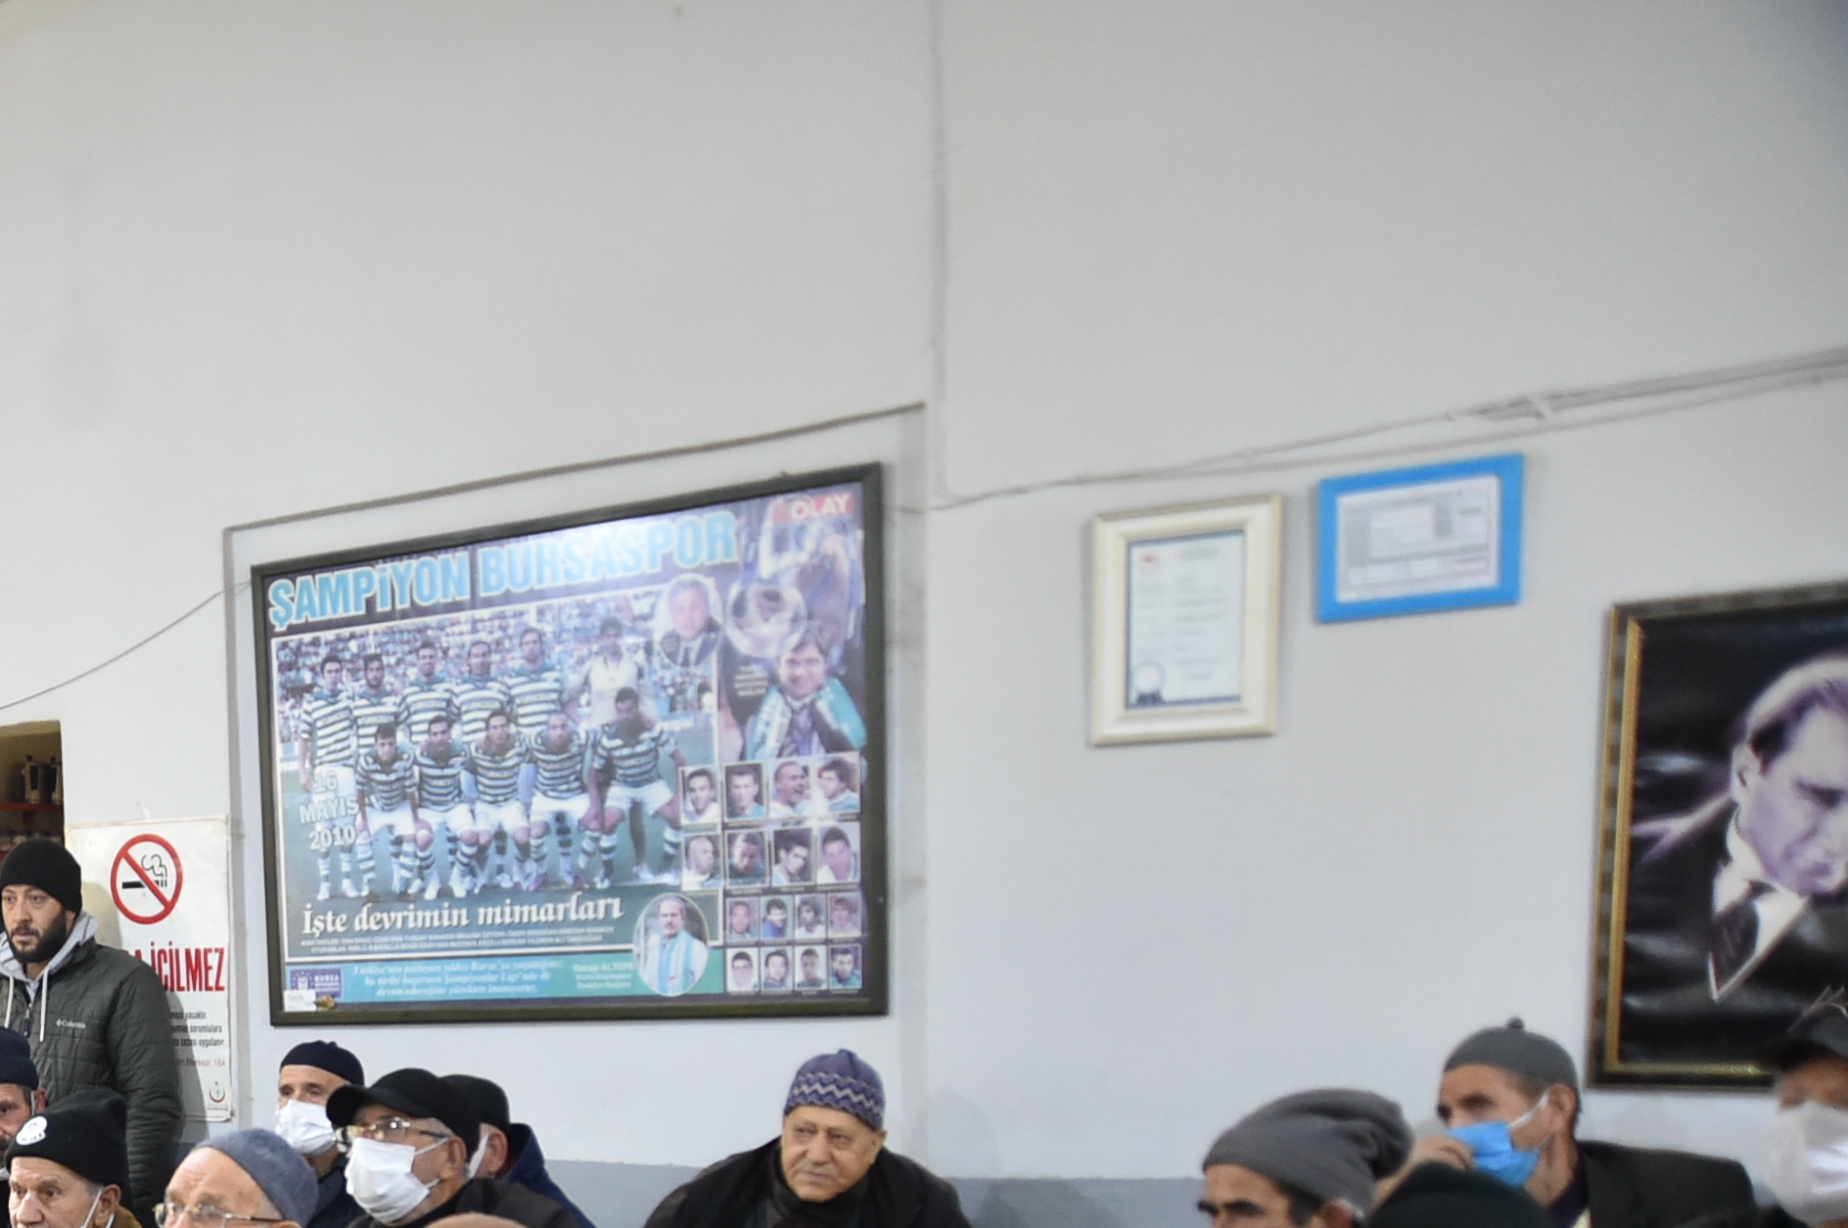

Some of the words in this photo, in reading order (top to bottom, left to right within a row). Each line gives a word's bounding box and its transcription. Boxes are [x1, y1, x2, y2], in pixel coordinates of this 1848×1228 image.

[791, 492, 851, 519] OLAY
[269, 551, 471, 631] ŞAMPİYON
[478, 511, 740, 598] BURSASPOR
[314, 770, 338, 794] 16
[299, 795, 360, 824] MAYIS
[309, 824, 357, 852] 2010
[302, 903, 348, 938] İşte
[354, 902, 470, 933] devrimin
[478, 891, 625, 927] mimarları
